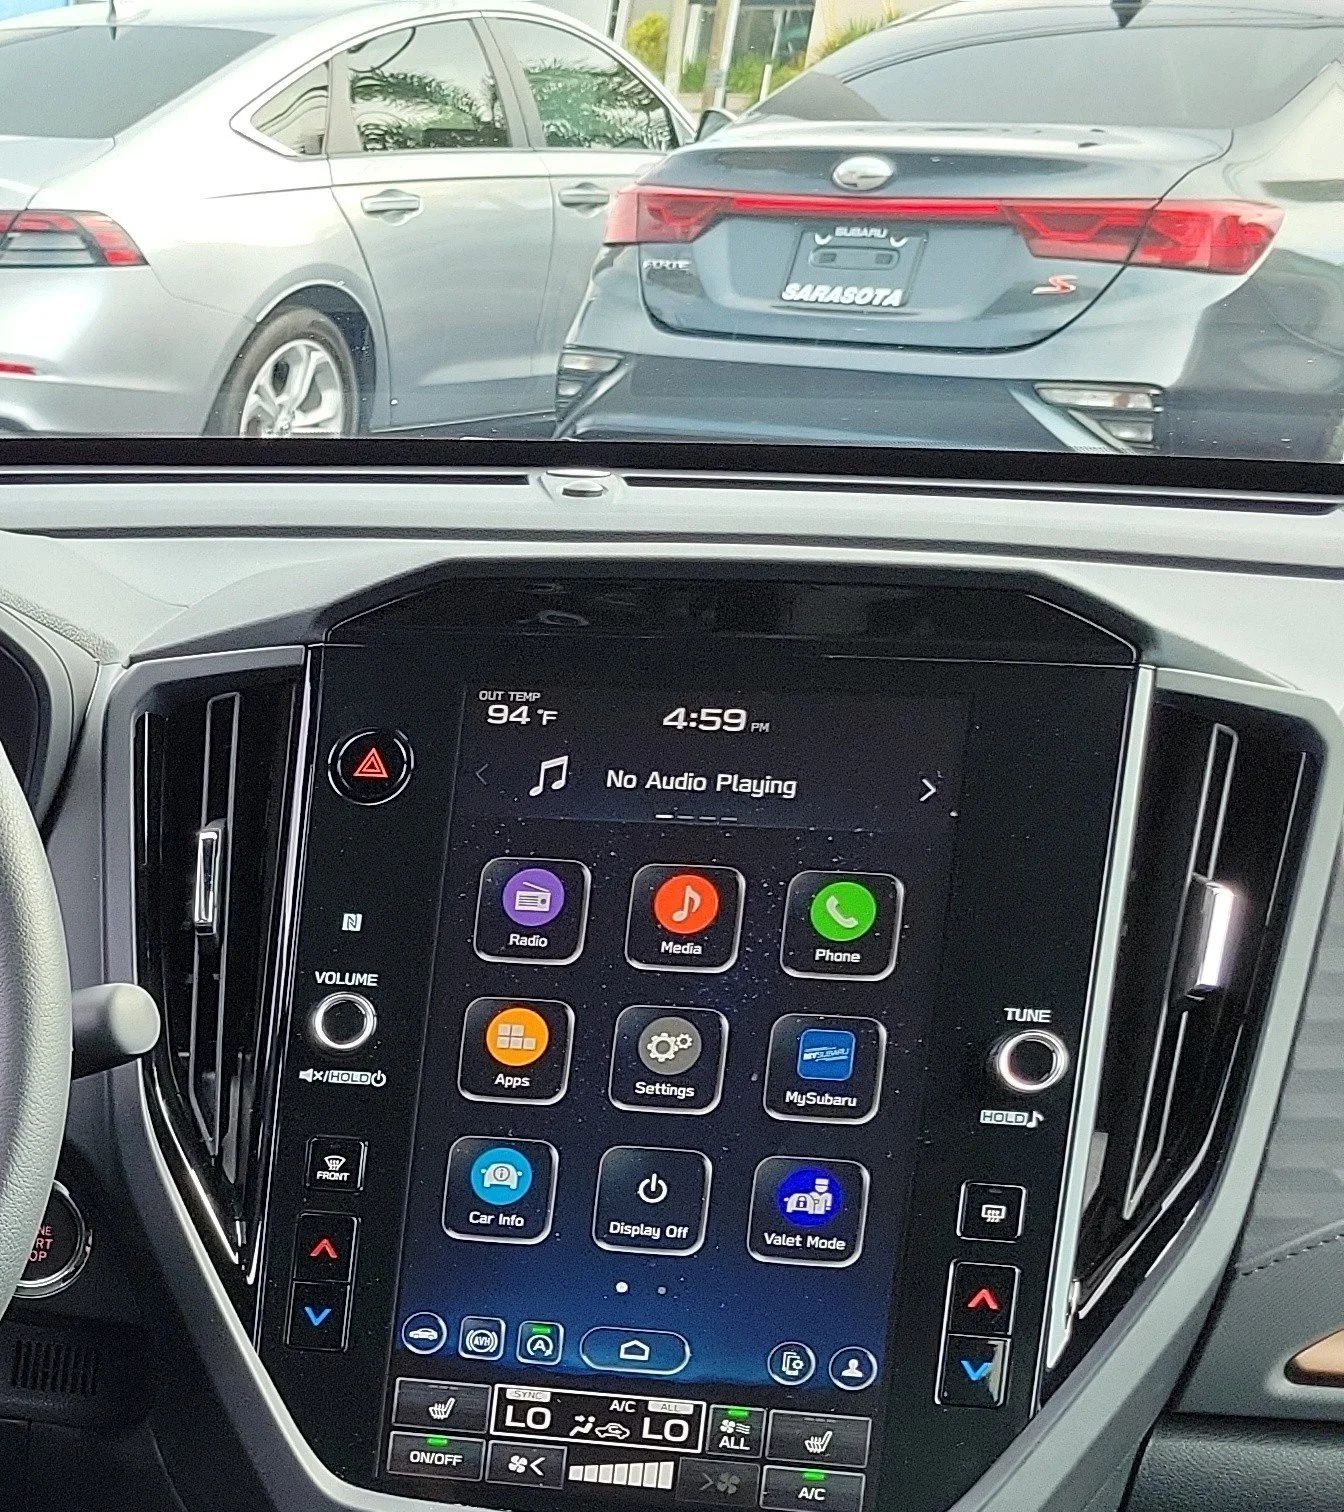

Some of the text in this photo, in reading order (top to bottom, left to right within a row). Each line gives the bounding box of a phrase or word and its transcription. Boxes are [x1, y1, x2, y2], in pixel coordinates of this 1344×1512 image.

[835, 226, 889, 238] SUBARU
[781, 283, 903, 307] SARASOTA
[478, 690, 541, 702] OUT TEMP
[487, 704, 531, 725] 94
[662, 707, 770, 733] 4:59 PM
[606, 769, 798, 799] No Audio Playing
[509, 934, 548, 948] Radio
[660, 941, 702, 955] Media
[814, 948, 861, 963] Phone
[314, 971, 379, 987] VOLUME
[1004, 1007, 1052, 1023] TUNE
[330, 1072, 370, 1084] HOLD
[494, 1073, 530, 1088] Apps
[634, 1082, 695, 1098] Settings
[785, 1090, 857, 1107] MySubaru
[982, 1111, 1026, 1125] HOLD
[316, 1170, 350, 1182] FRONT
[468, 1211, 525, 1227] Car Info
[609, 1221, 689, 1239] Display Off
[763, 1232, 846, 1250] Valet Mode
[29, 1250, 47, 1262] OP
[474, 1336, 491, 1346] AVH
[513, 1390, 544, 1400] SYNC
[609, 1399, 637, 1413] A/C
[504, 1405, 552, 1429] LO
[642, 1417, 689, 1442] LO
[718, 1436, 751, 1450] ALL
[409, 1451, 463, 1467] ON/OFF
[798, 1487, 826, 1501] A/C
